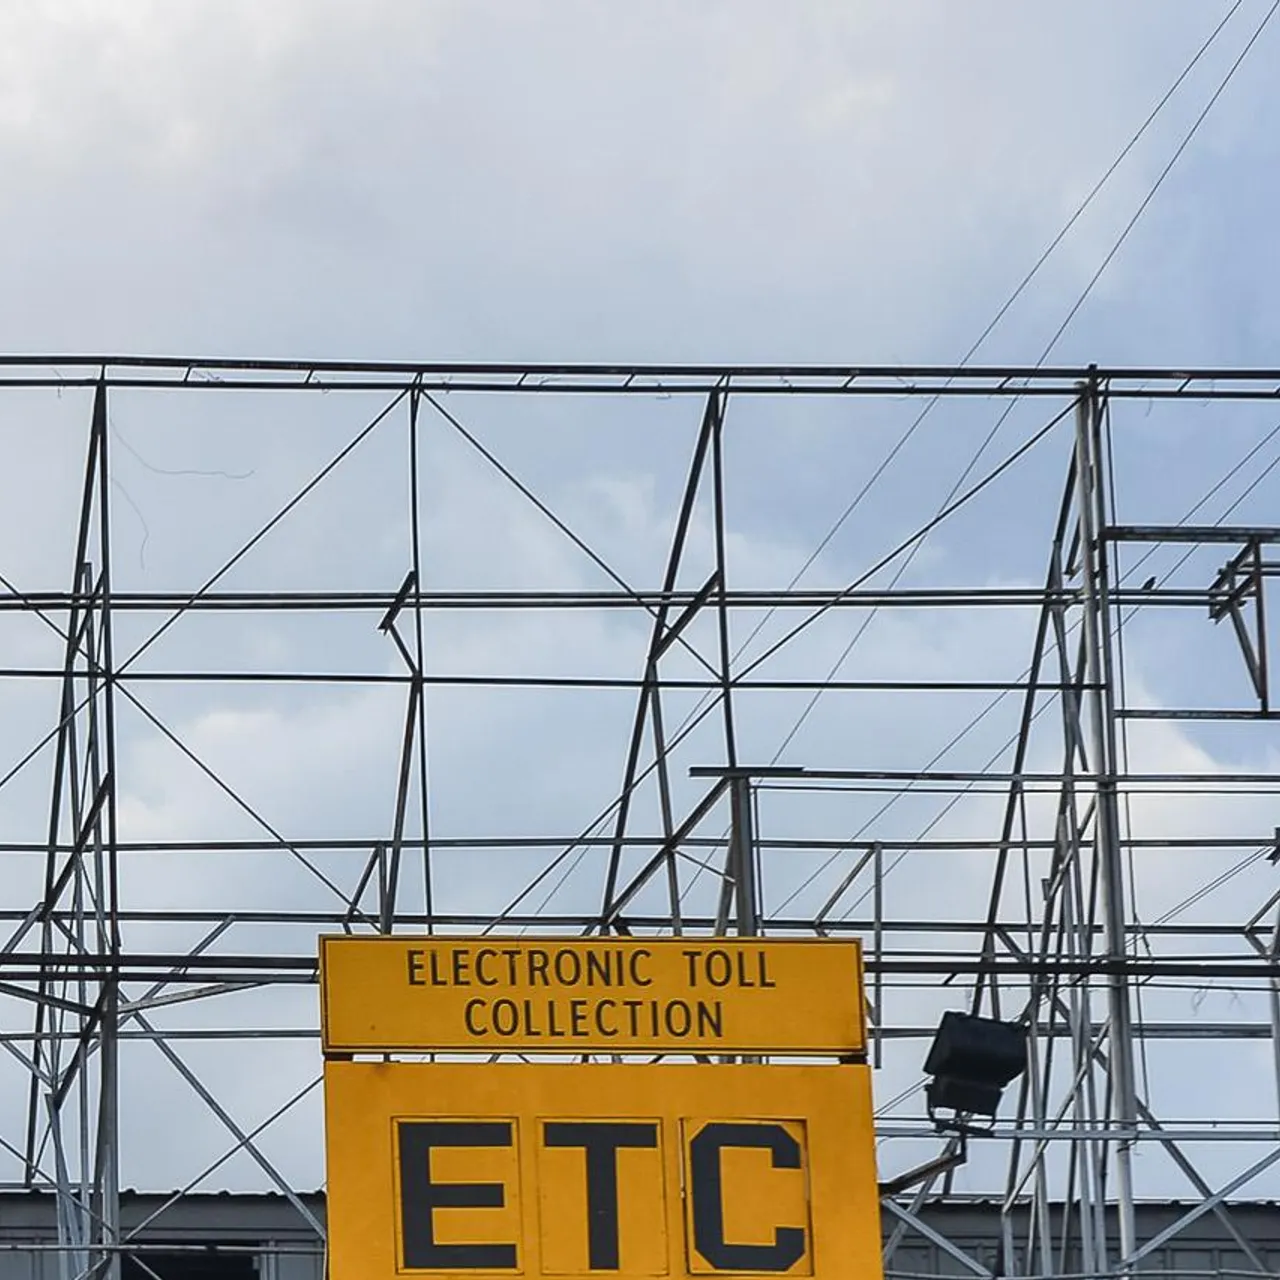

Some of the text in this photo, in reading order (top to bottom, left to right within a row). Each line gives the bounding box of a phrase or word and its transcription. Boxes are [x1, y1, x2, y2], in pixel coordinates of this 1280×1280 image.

[408, 950, 776, 988] ELECTRONIC TOLL
[465, 999, 723, 1038] COLLECTION
[397, 1122, 805, 1272] ETC
